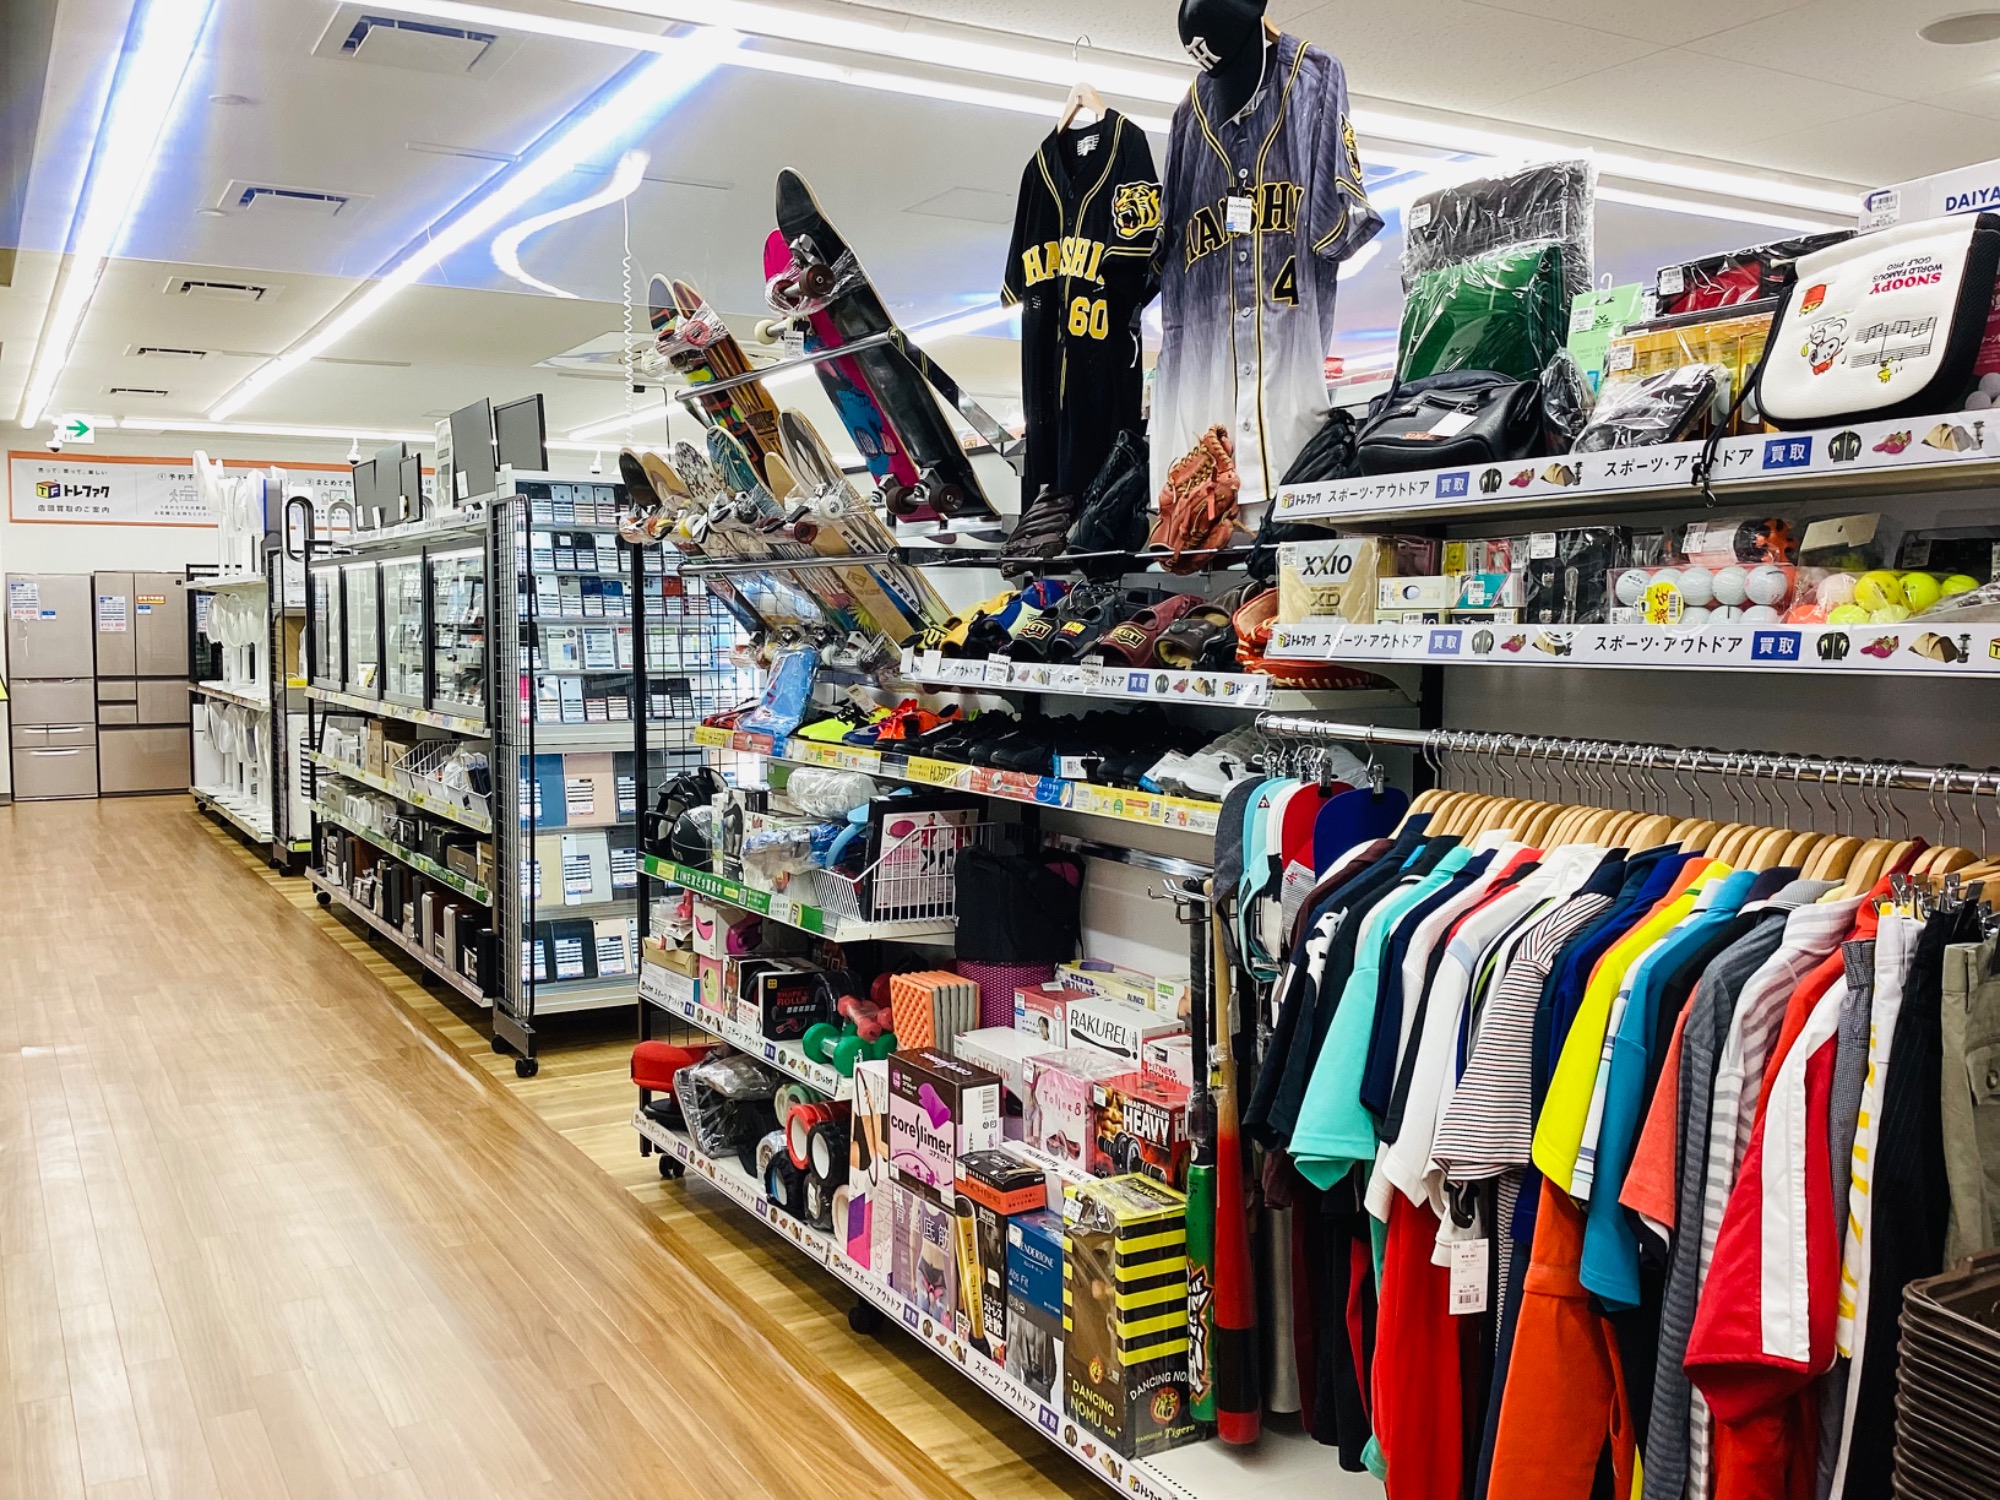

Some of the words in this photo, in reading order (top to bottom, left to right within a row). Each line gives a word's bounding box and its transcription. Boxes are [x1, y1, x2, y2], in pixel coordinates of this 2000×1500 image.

[1887, 261, 1905, 270] PRO
[1908, 263, 1942, 276] WORLD
[1909, 256, 1932, 266] GOLF
[1271, 255, 1300, 307] 4
[1869, 272, 1942, 295] SNOOPY
[1873, 268, 1907, 282] FAMOUS
[1068, 296, 1109, 340] 60
[1770, 443, 1805, 463] 買取
[64, 485, 110, 498] トレファク
[1328, 480, 1430, 503] スポーツ・アウトドア
[1440, 478, 1465, 494] 買取
[38, 504, 110, 513] 店頭買取のご案内
[1302, 546, 1353, 577] XXIO
[1433, 634, 1457, 649] 買取
[1594, 634, 1743, 654] スポーツ・アウトドア
[1758, 636, 1796, 655] 買取
[1123, 1105, 1170, 1147] HEAVY
[854, 1271, 902, 1311] スポーツ・アウトドア
[975, 1360, 1036, 1412] スポーツ・アウトドア
[1129, 1372, 1171, 1400] DANCING
[1173, 1371, 1188, 1382] NO
[1073, 1379, 1115, 1418] DANCING
[1070, 1395, 1102, 1428] NOMU
